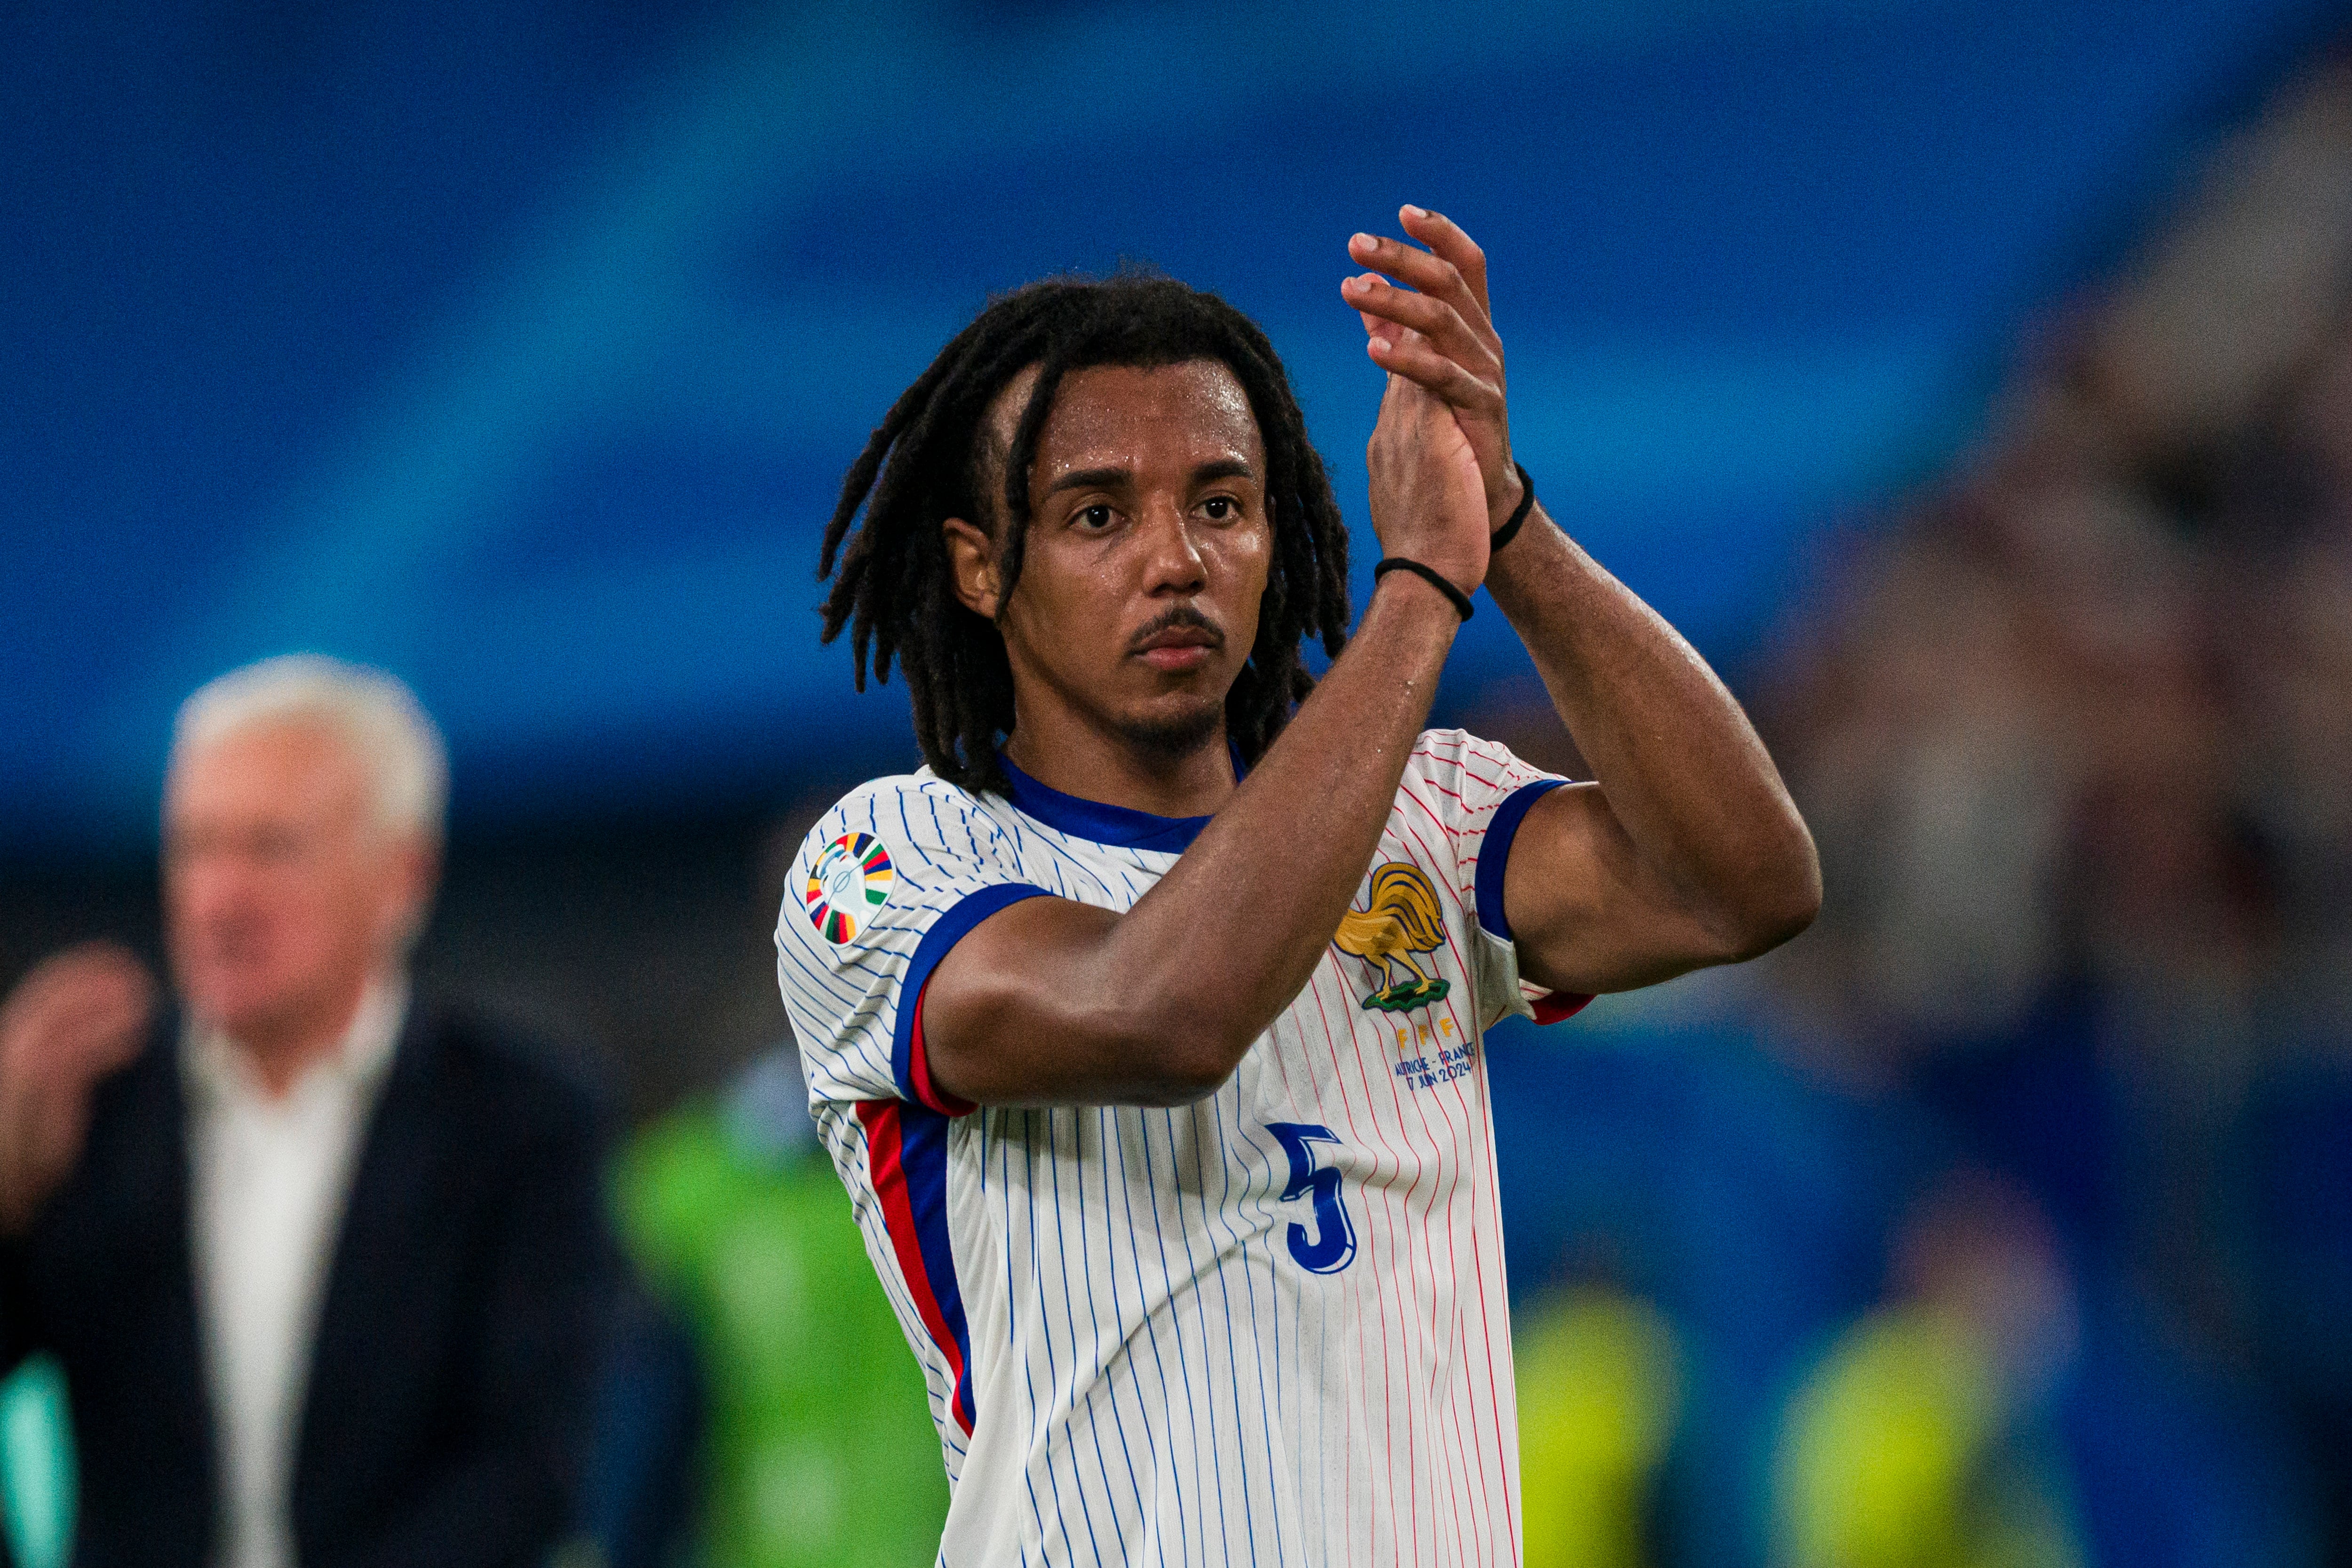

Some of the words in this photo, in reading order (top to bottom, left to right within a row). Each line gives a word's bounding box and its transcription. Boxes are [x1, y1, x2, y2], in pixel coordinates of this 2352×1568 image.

[1394, 1057, 1430, 1076] AUTRICHE
[1438, 1061, 1471, 1082] 2024
[1263, 1122, 1357, 1274] 5
